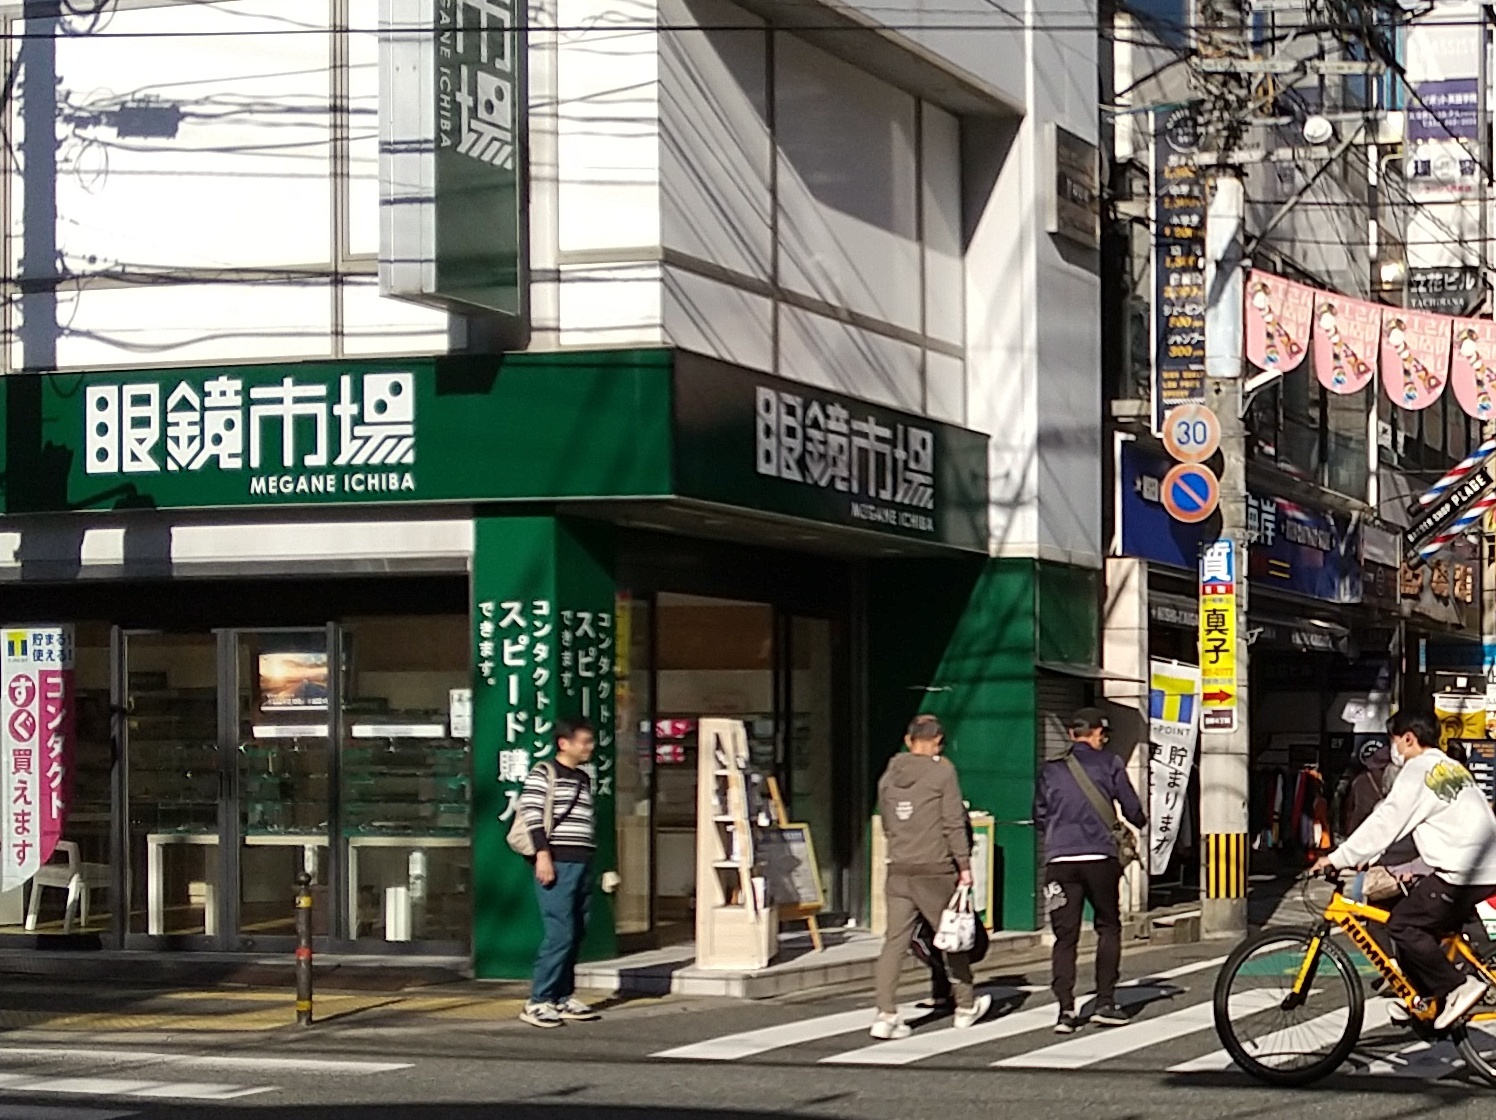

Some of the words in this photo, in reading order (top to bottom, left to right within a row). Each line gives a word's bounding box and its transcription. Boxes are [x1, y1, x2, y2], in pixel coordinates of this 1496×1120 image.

[440, 64, 451, 148] ICHIBA
[1410, 271, 1476, 293] 立花ビル
[85, 372, 415, 474] 眼鏡市場
[755, 385, 934, 511] 眼鏡市場
[1176, 421, 1208, 445] 30
[250, 475, 336, 495] MEGANE
[343, 472, 415, 492] ICHIBA
[32, 632, 72, 648] 貯まる!
[32, 648, 73, 663] 使える!
[478, 601, 496, 686] できます。
[560, 610, 575, 697] できます。
[1204, 607, 1230, 665] 真子
[532, 600, 551, 759] コンタクトレン
[10, 677, 34, 867] すぐ買えます
[46, 676, 66, 820] コンタクト
[1339, 915, 1413, 1002] HUMMER
